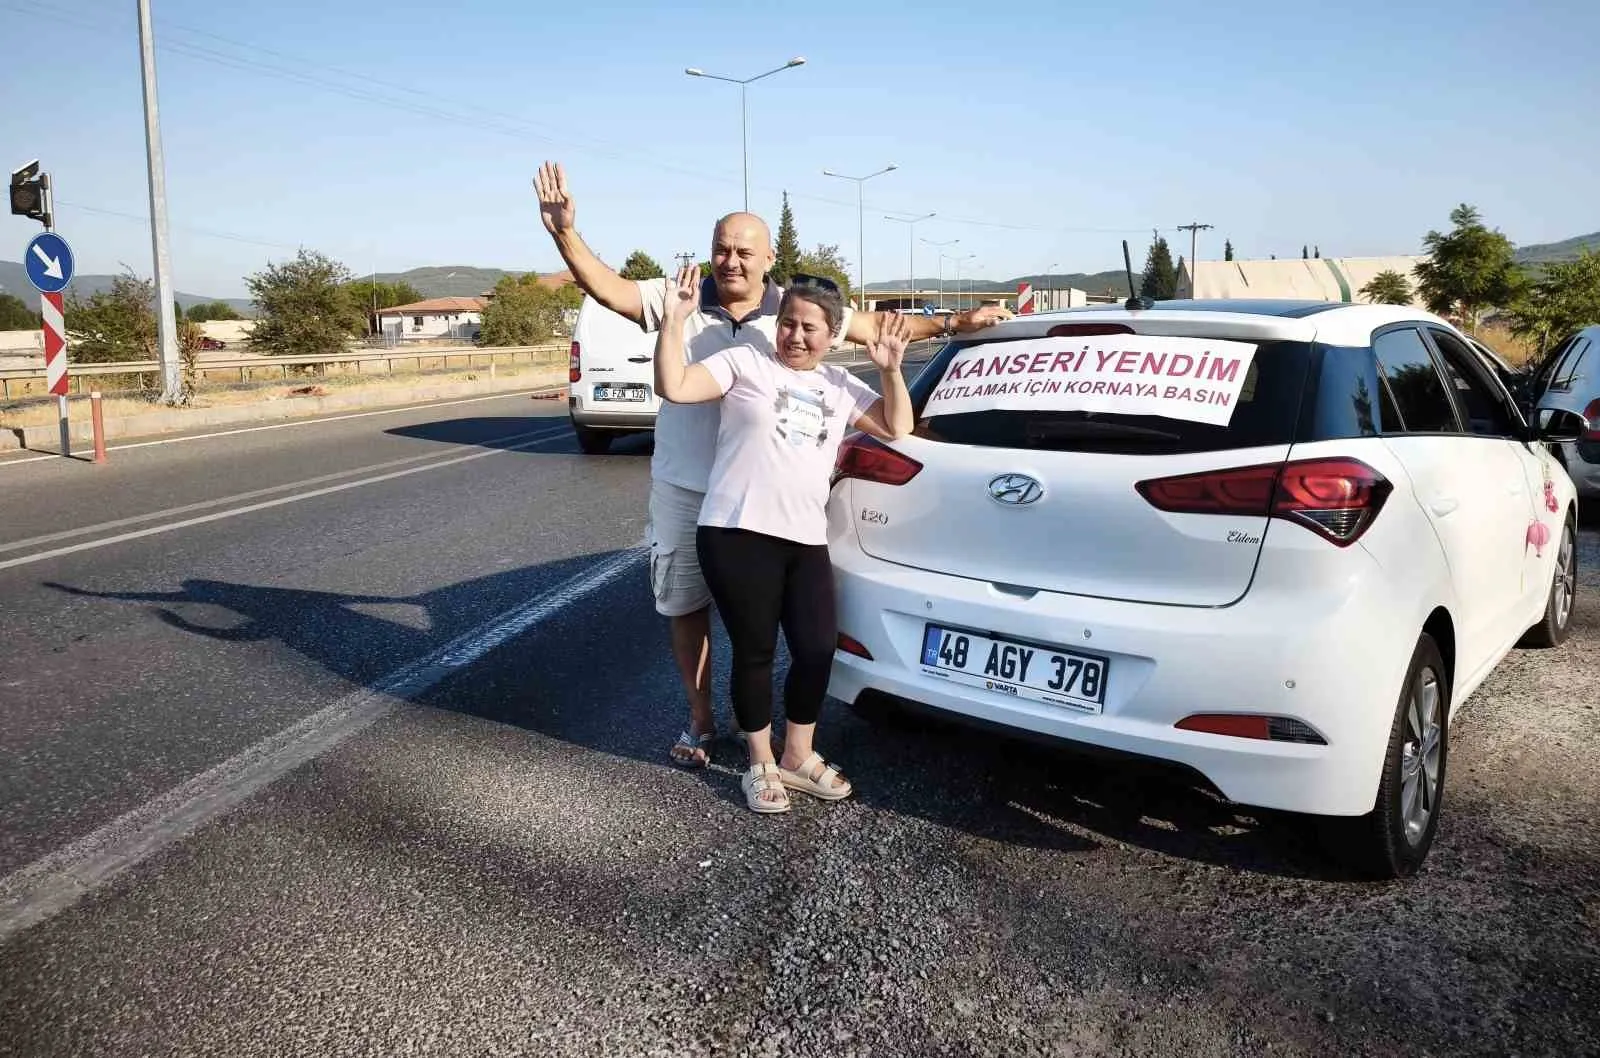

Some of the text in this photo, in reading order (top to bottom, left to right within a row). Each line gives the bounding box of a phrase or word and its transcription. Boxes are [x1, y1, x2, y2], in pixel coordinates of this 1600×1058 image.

[946, 345, 1241, 382] KANSERİ YENDİM
[599, 388, 608, 398] 06
[612, 388, 626, 398] FZN
[933, 379, 1231, 406] KUTLAMAK İÇİN KORNAYA BASIN
[939, 633, 969, 669] 48
[984, 642, 1034, 682] AGY
[1048, 655, 1100, 698] 378
[994, 682, 1018, 696] VARTA
